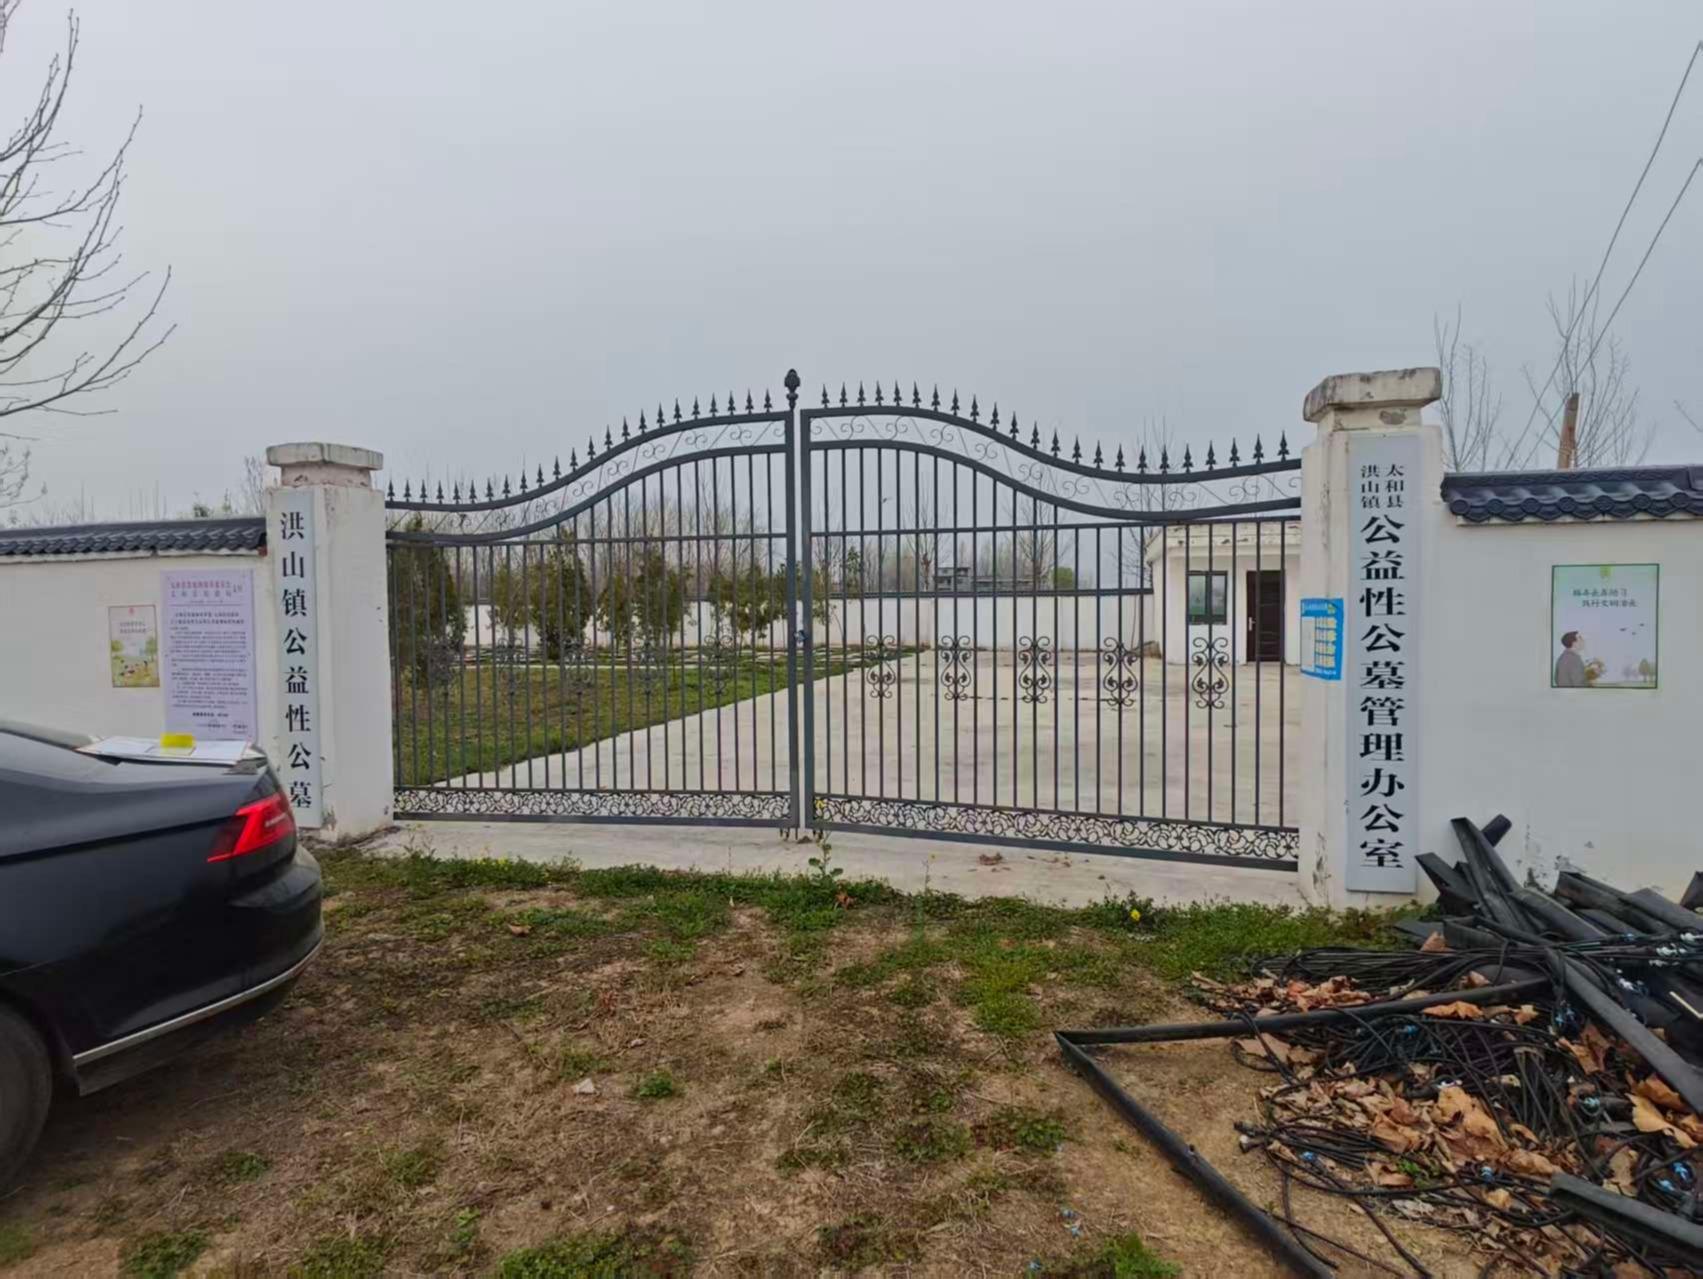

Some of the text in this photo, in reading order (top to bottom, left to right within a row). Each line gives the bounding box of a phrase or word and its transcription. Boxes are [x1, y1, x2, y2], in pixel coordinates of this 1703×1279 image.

[1361, 464, 1380, 509] 洪山镇
[1386, 463, 1405, 508] 太和县
[280, 512, 312, 809] 洪山镇公益性公墓
[1359, 514, 1406, 869] 公益性公墓管理办公室
